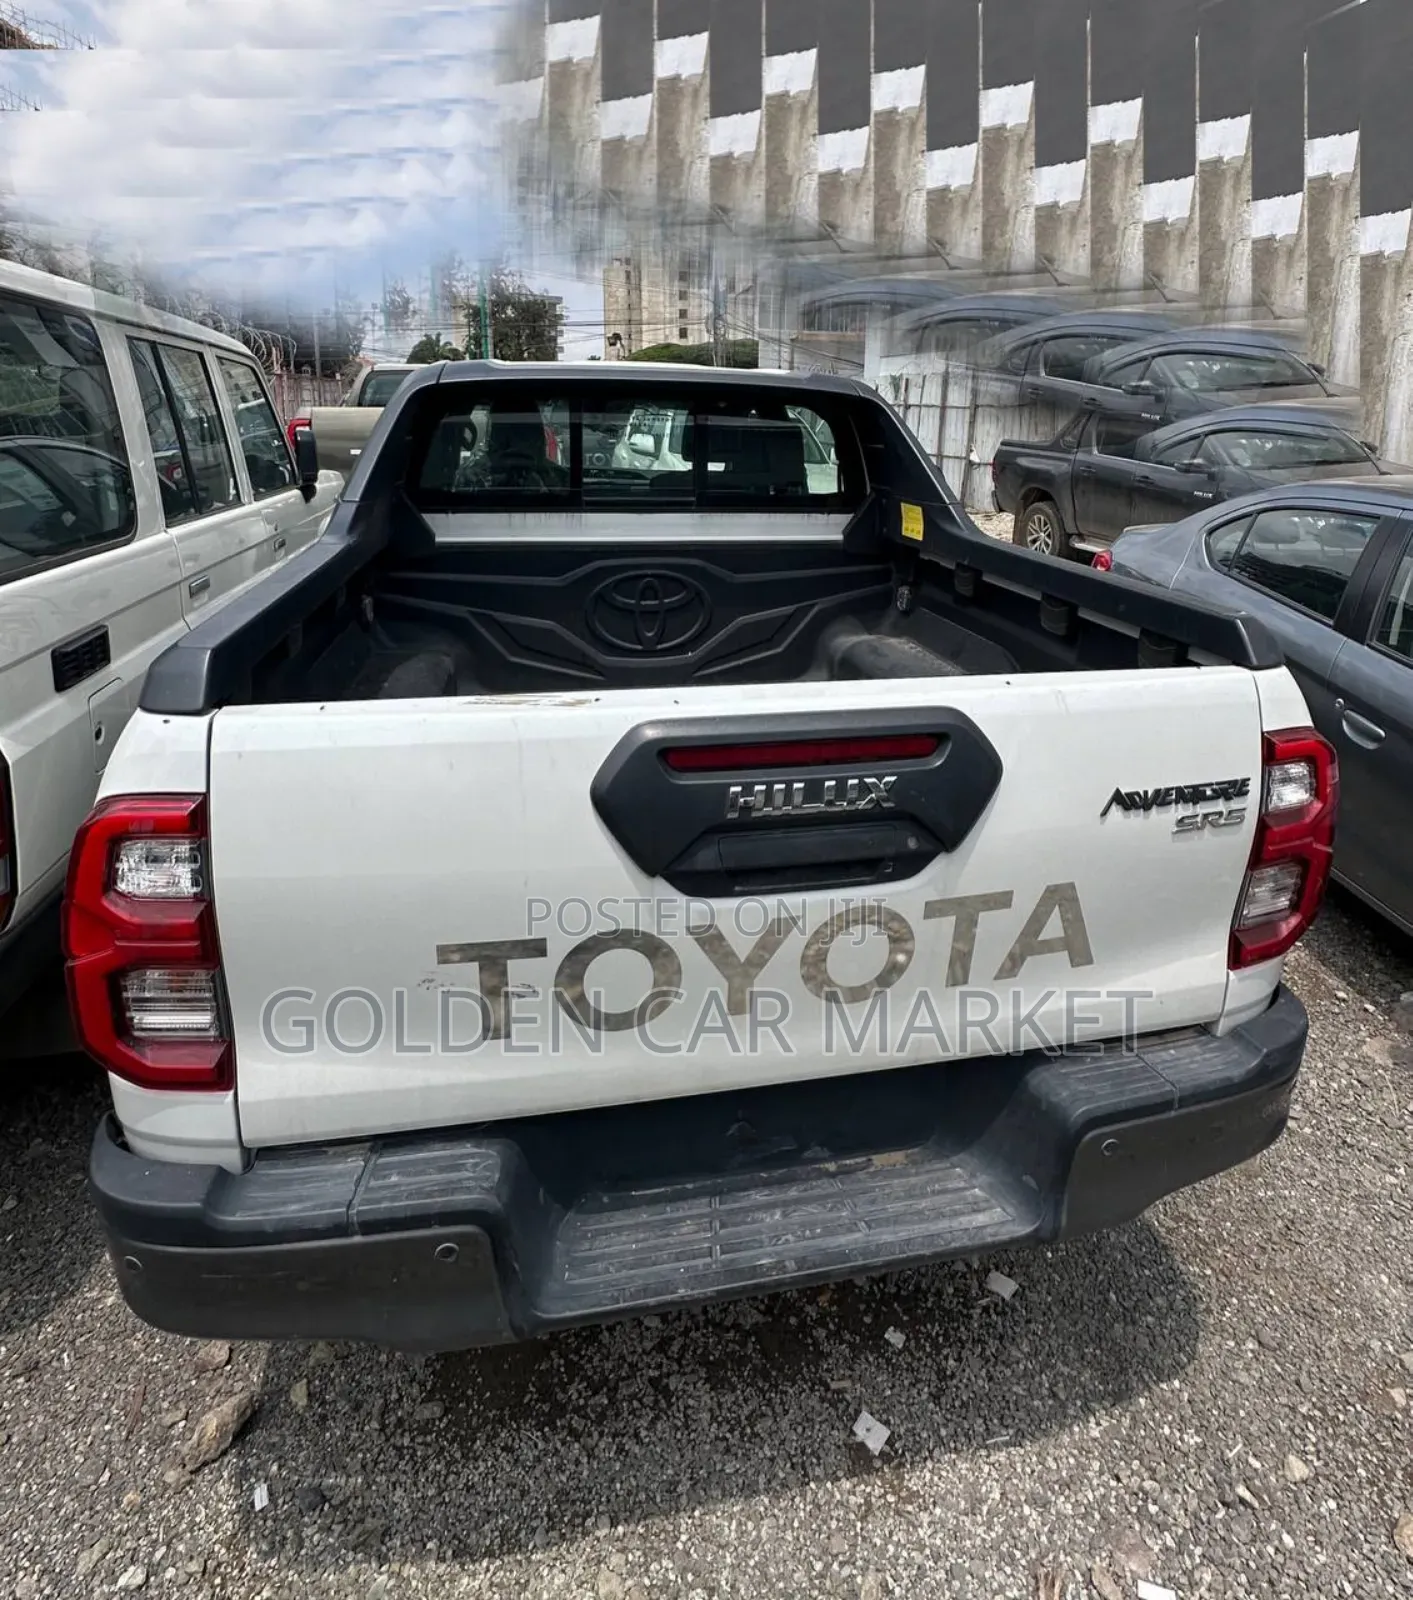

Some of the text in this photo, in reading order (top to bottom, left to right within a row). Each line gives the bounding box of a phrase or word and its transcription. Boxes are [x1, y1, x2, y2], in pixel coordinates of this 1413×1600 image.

[726, 775, 898, 819] HILUX
[1100, 777, 1251, 817] ADVENTURE
[1171, 807, 1247, 834] SR5
[436, 882, 1094, 1041] TOYOTA
